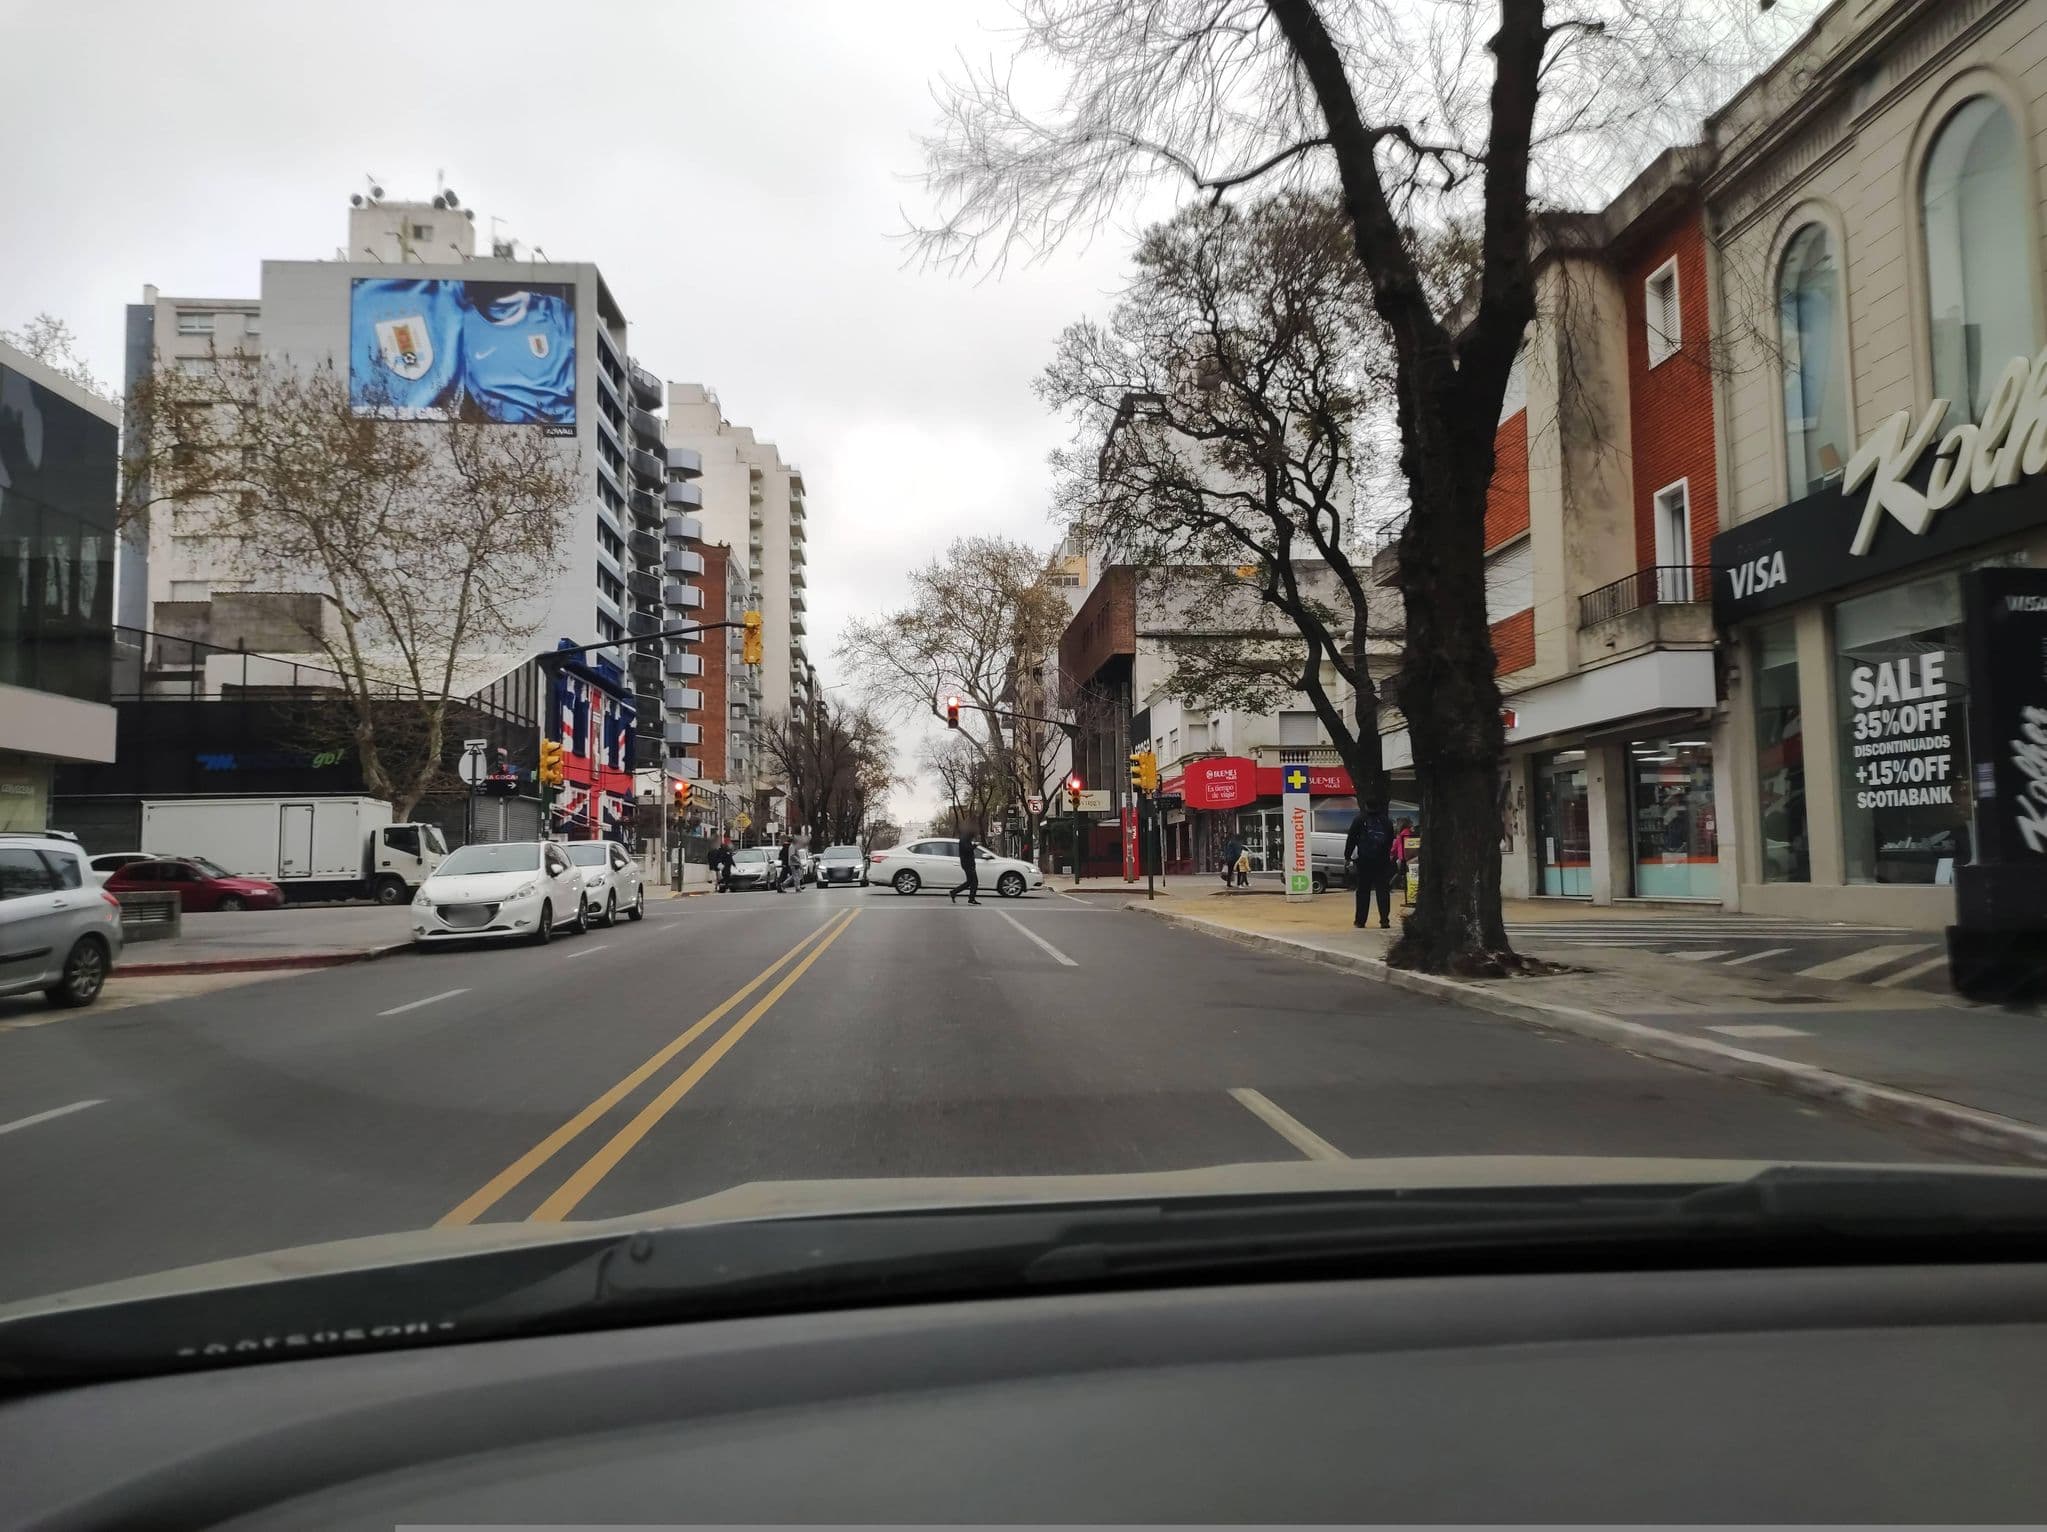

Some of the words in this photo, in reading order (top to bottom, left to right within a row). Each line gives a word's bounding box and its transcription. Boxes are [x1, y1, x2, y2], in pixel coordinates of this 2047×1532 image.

[1726, 550, 1787, 599] VISA
[1851, 650, 1947, 709] SALE
[1853, 700, 1948, 740] 35%OFF
[1854, 735, 1951, 758] DISCONTINUADOS
[1856, 755, 1952, 786] +15%OFF
[1857, 786, 1953, 809] SCOTIABANK
[1291, 807, 1307, 873] farmacity
